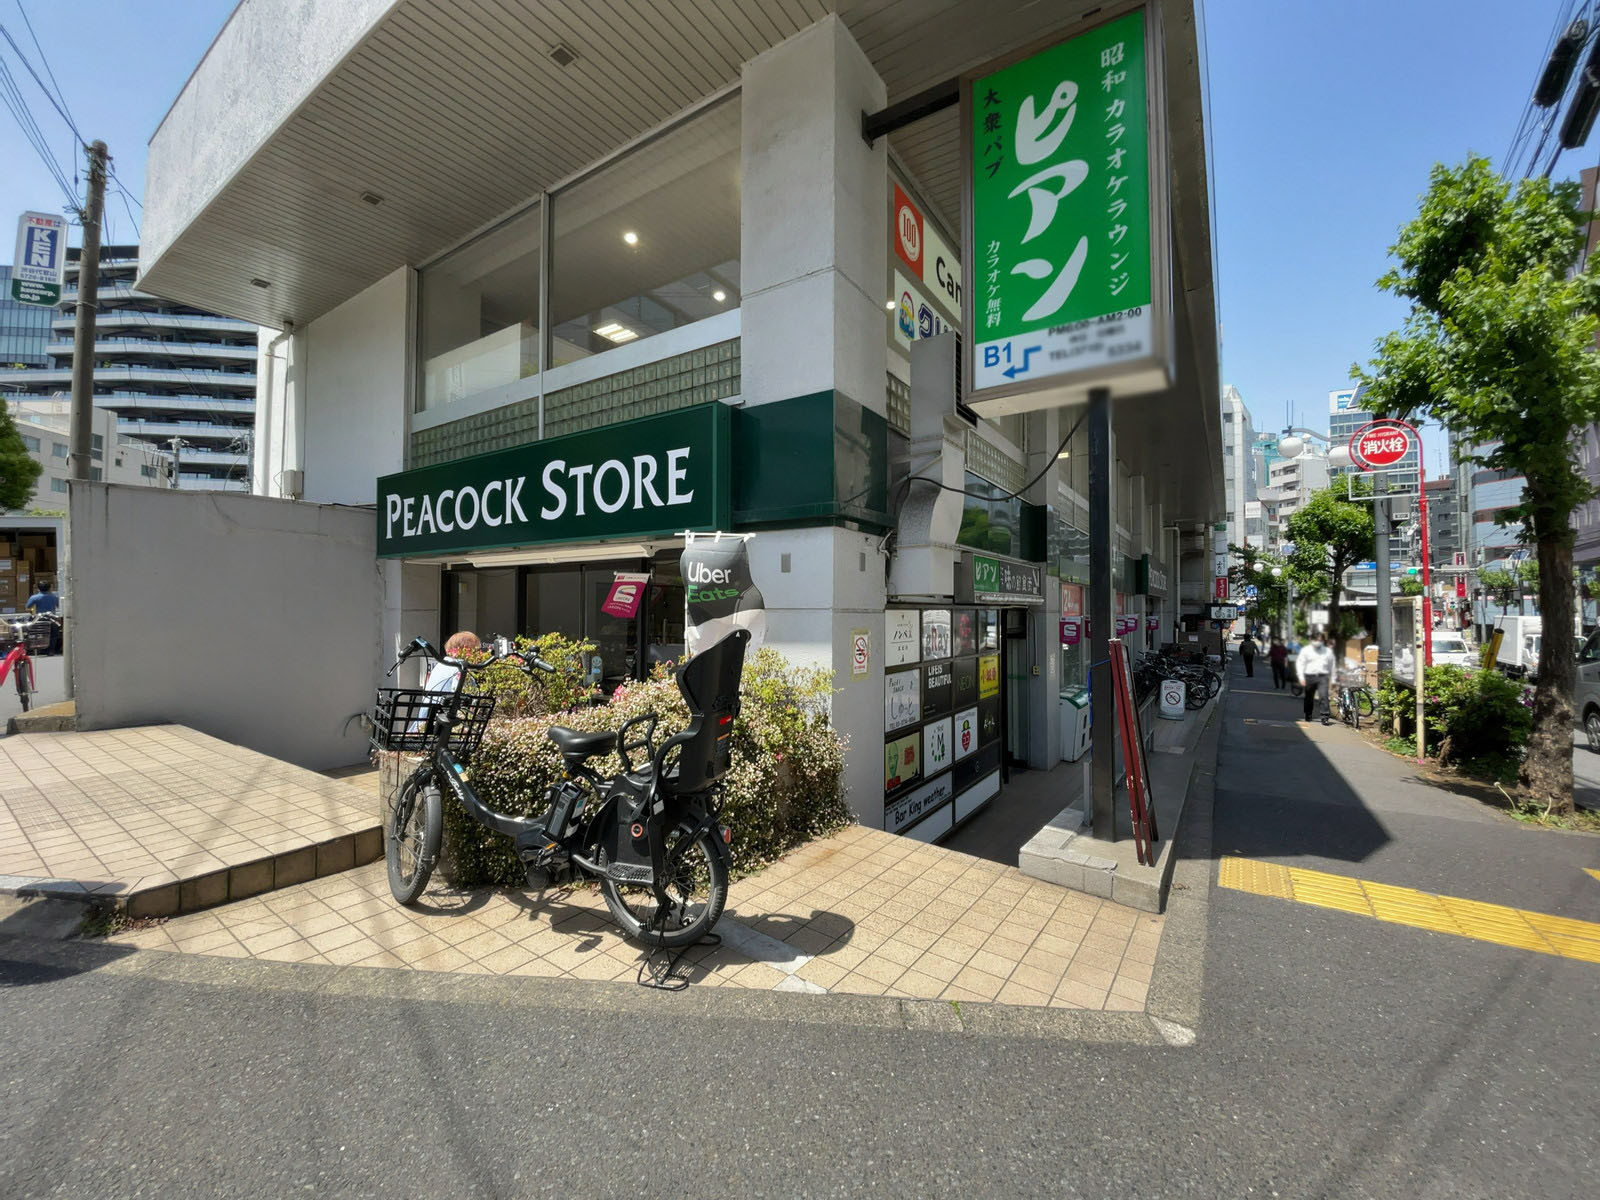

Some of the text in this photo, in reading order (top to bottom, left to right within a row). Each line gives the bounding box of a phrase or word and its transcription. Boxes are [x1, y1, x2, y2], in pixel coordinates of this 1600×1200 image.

[1008, 80, 1090, 322] ピアン
[30, 228, 52, 268] KEN
[903, 213, 916, 248] 100
[985, 240, 1002, 328] カラオケ無料
[984, 342, 1012, 368] B1
[1363, 437, 1404, 456] 消火栓
[385, 446, 695, 540] PEACOCK STORE
[687, 561, 732, 584] Uber
[687, 584, 740, 603] Eats
